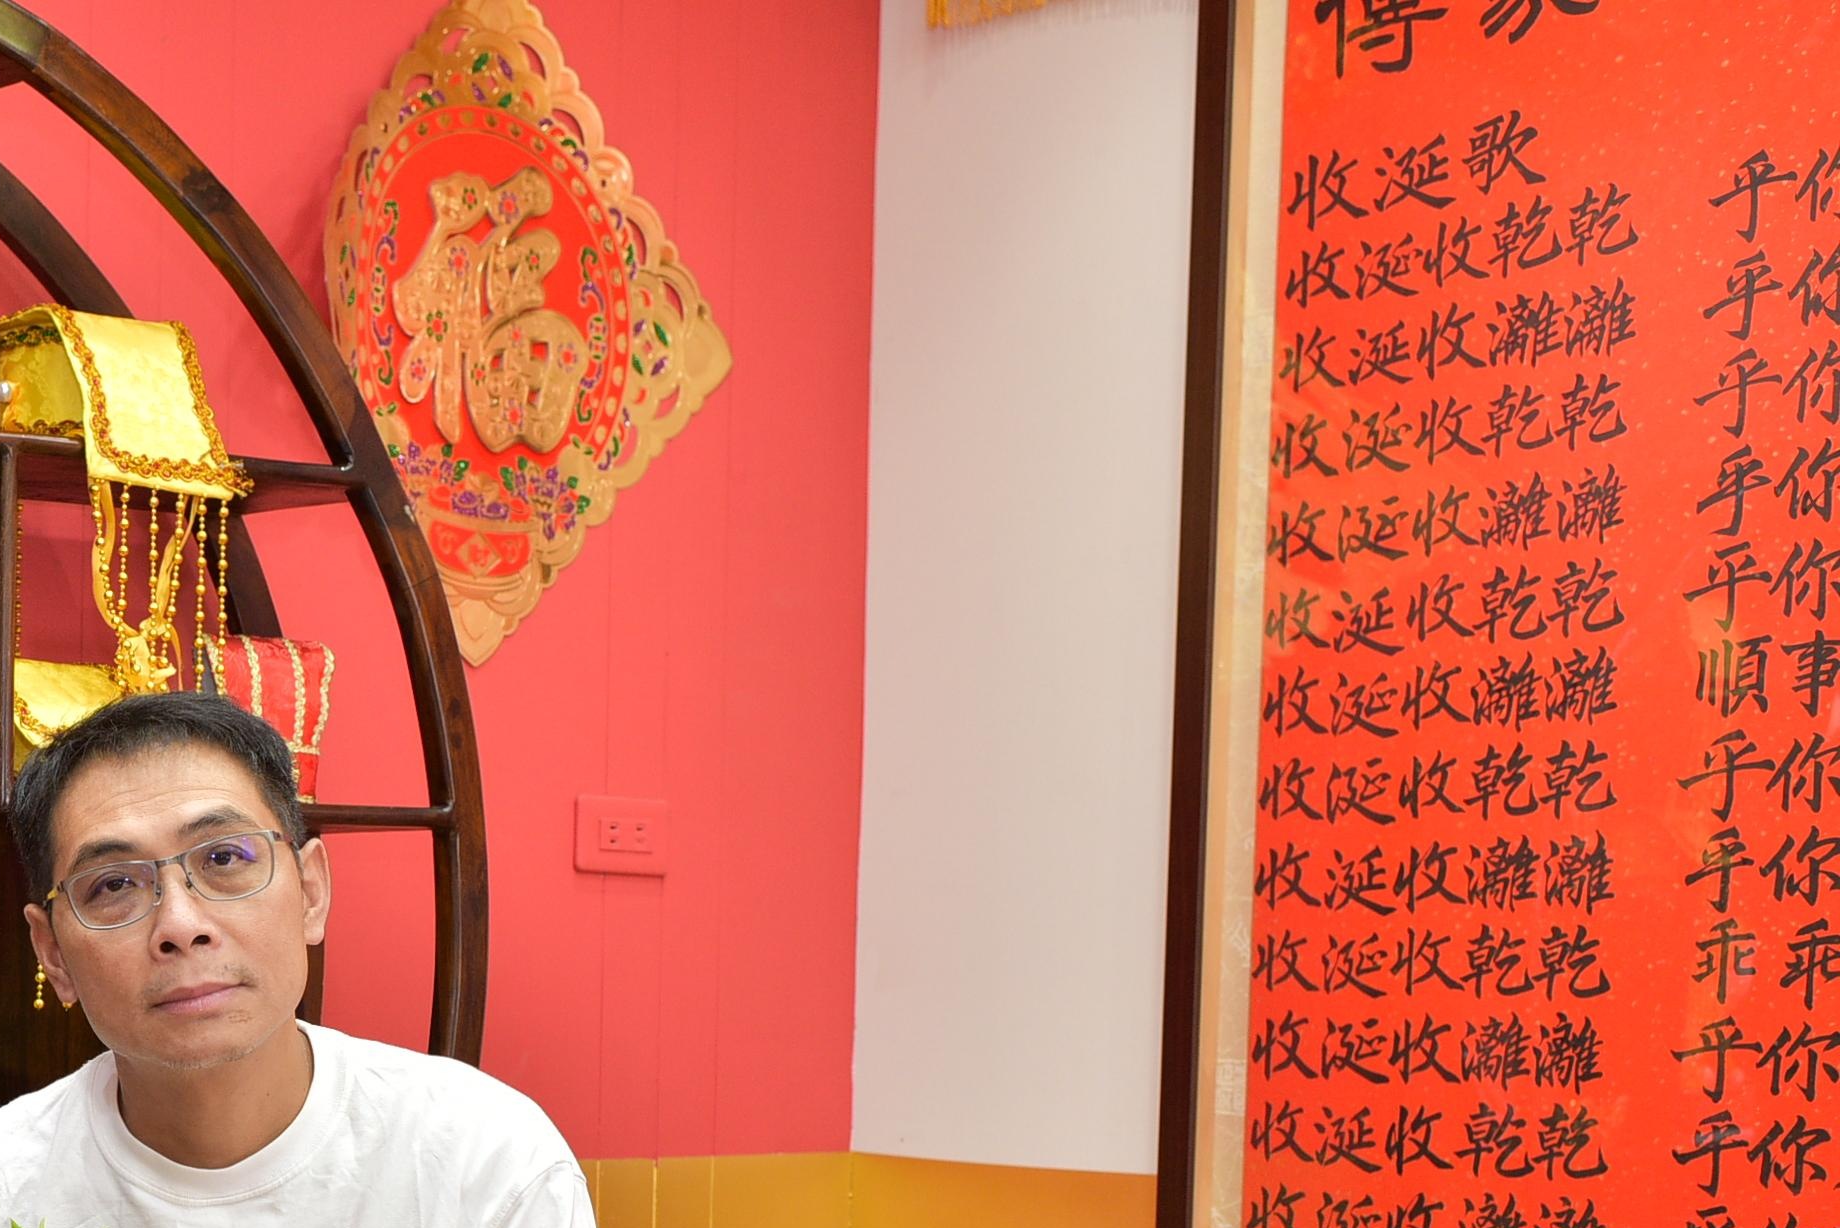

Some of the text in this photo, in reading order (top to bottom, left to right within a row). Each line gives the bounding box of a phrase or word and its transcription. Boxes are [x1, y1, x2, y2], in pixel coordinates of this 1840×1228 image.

[1288, 111, 1545, 230] 收涎歌
[392, 166, 590, 454] 福
[1672, 1111, 1840, 1197] 乎你
